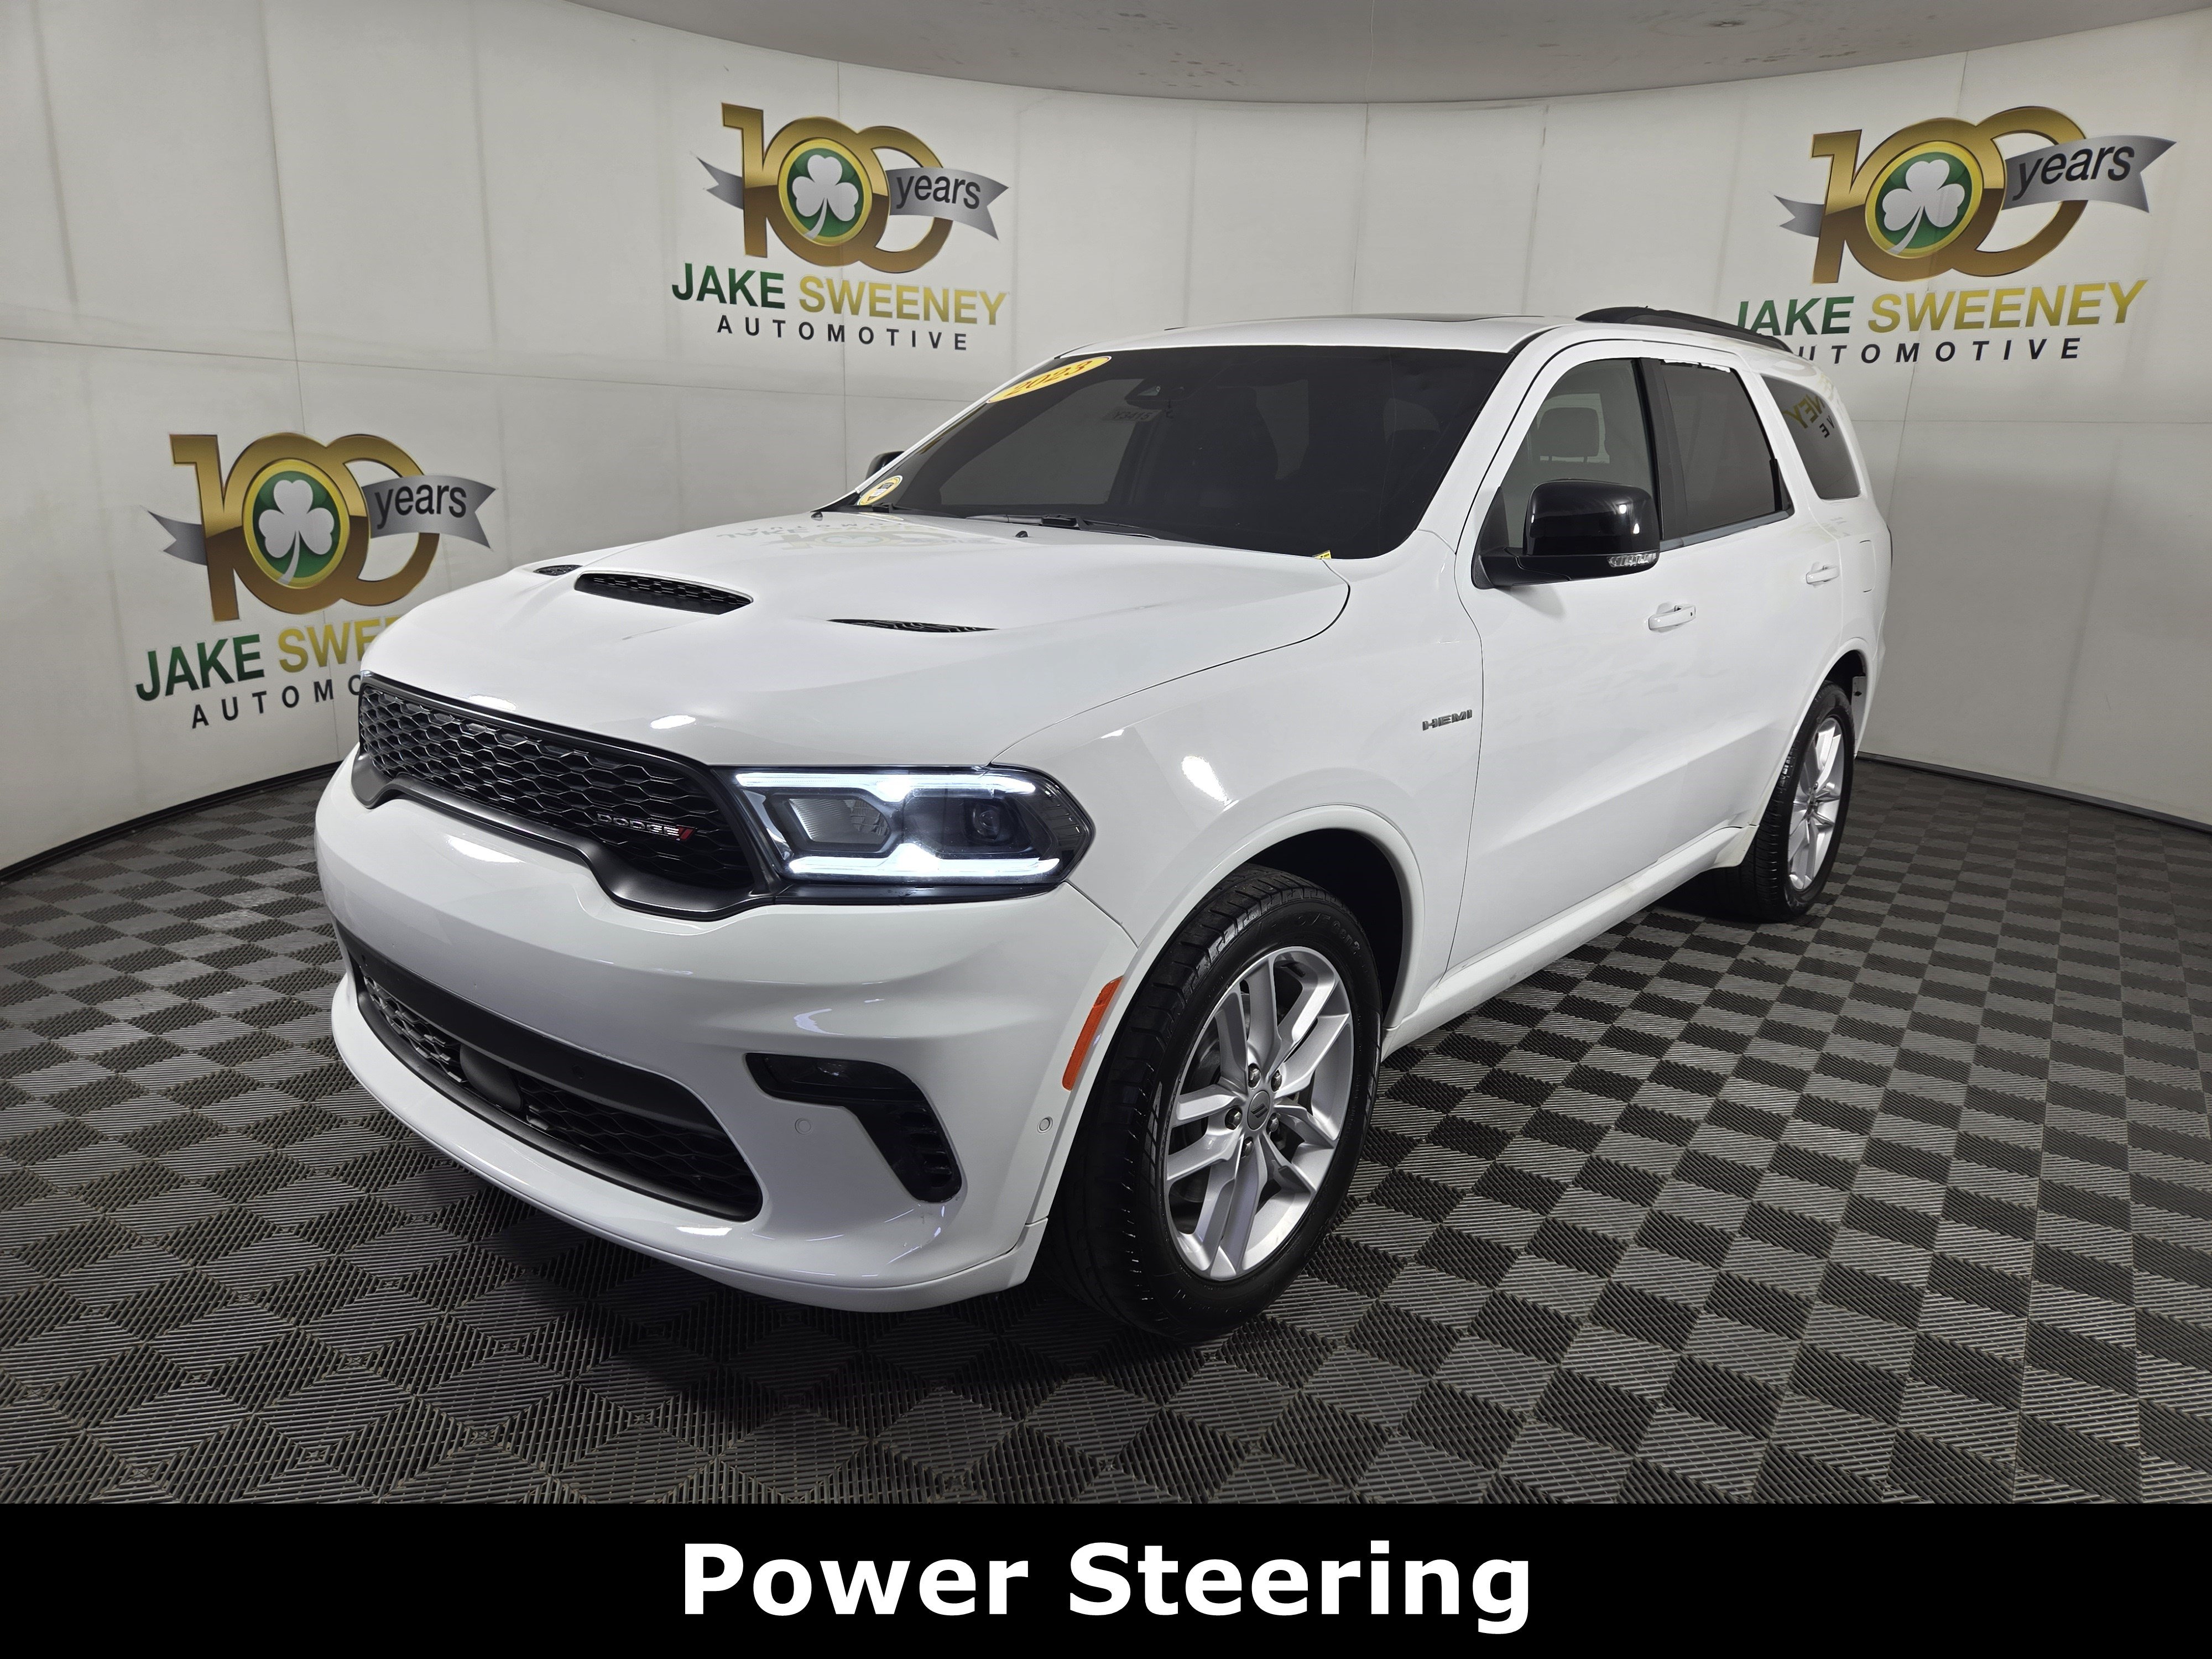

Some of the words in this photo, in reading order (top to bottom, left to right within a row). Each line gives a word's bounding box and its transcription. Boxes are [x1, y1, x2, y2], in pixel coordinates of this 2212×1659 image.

[2012, 145, 2135, 201] years
[896, 174, 980, 210] years
[671, 263, 785, 309] JAKE
[799, 275, 1006, 325] SWEENEY
[1868, 279, 2148, 333] SWEENEY
[717, 315, 967, 350] AUTOMOTIVE
[1798, 337, 2081, 364] UTOMOTIVE
[1004, 360, 1093, 397] 2023
[376, 484, 467, 530] years
[136, 634, 265, 701] JAKE
[278, 615, 401, 673] SWE
[1422, 709, 1472, 731] HEMI
[597, 813, 679, 836] DODGE
